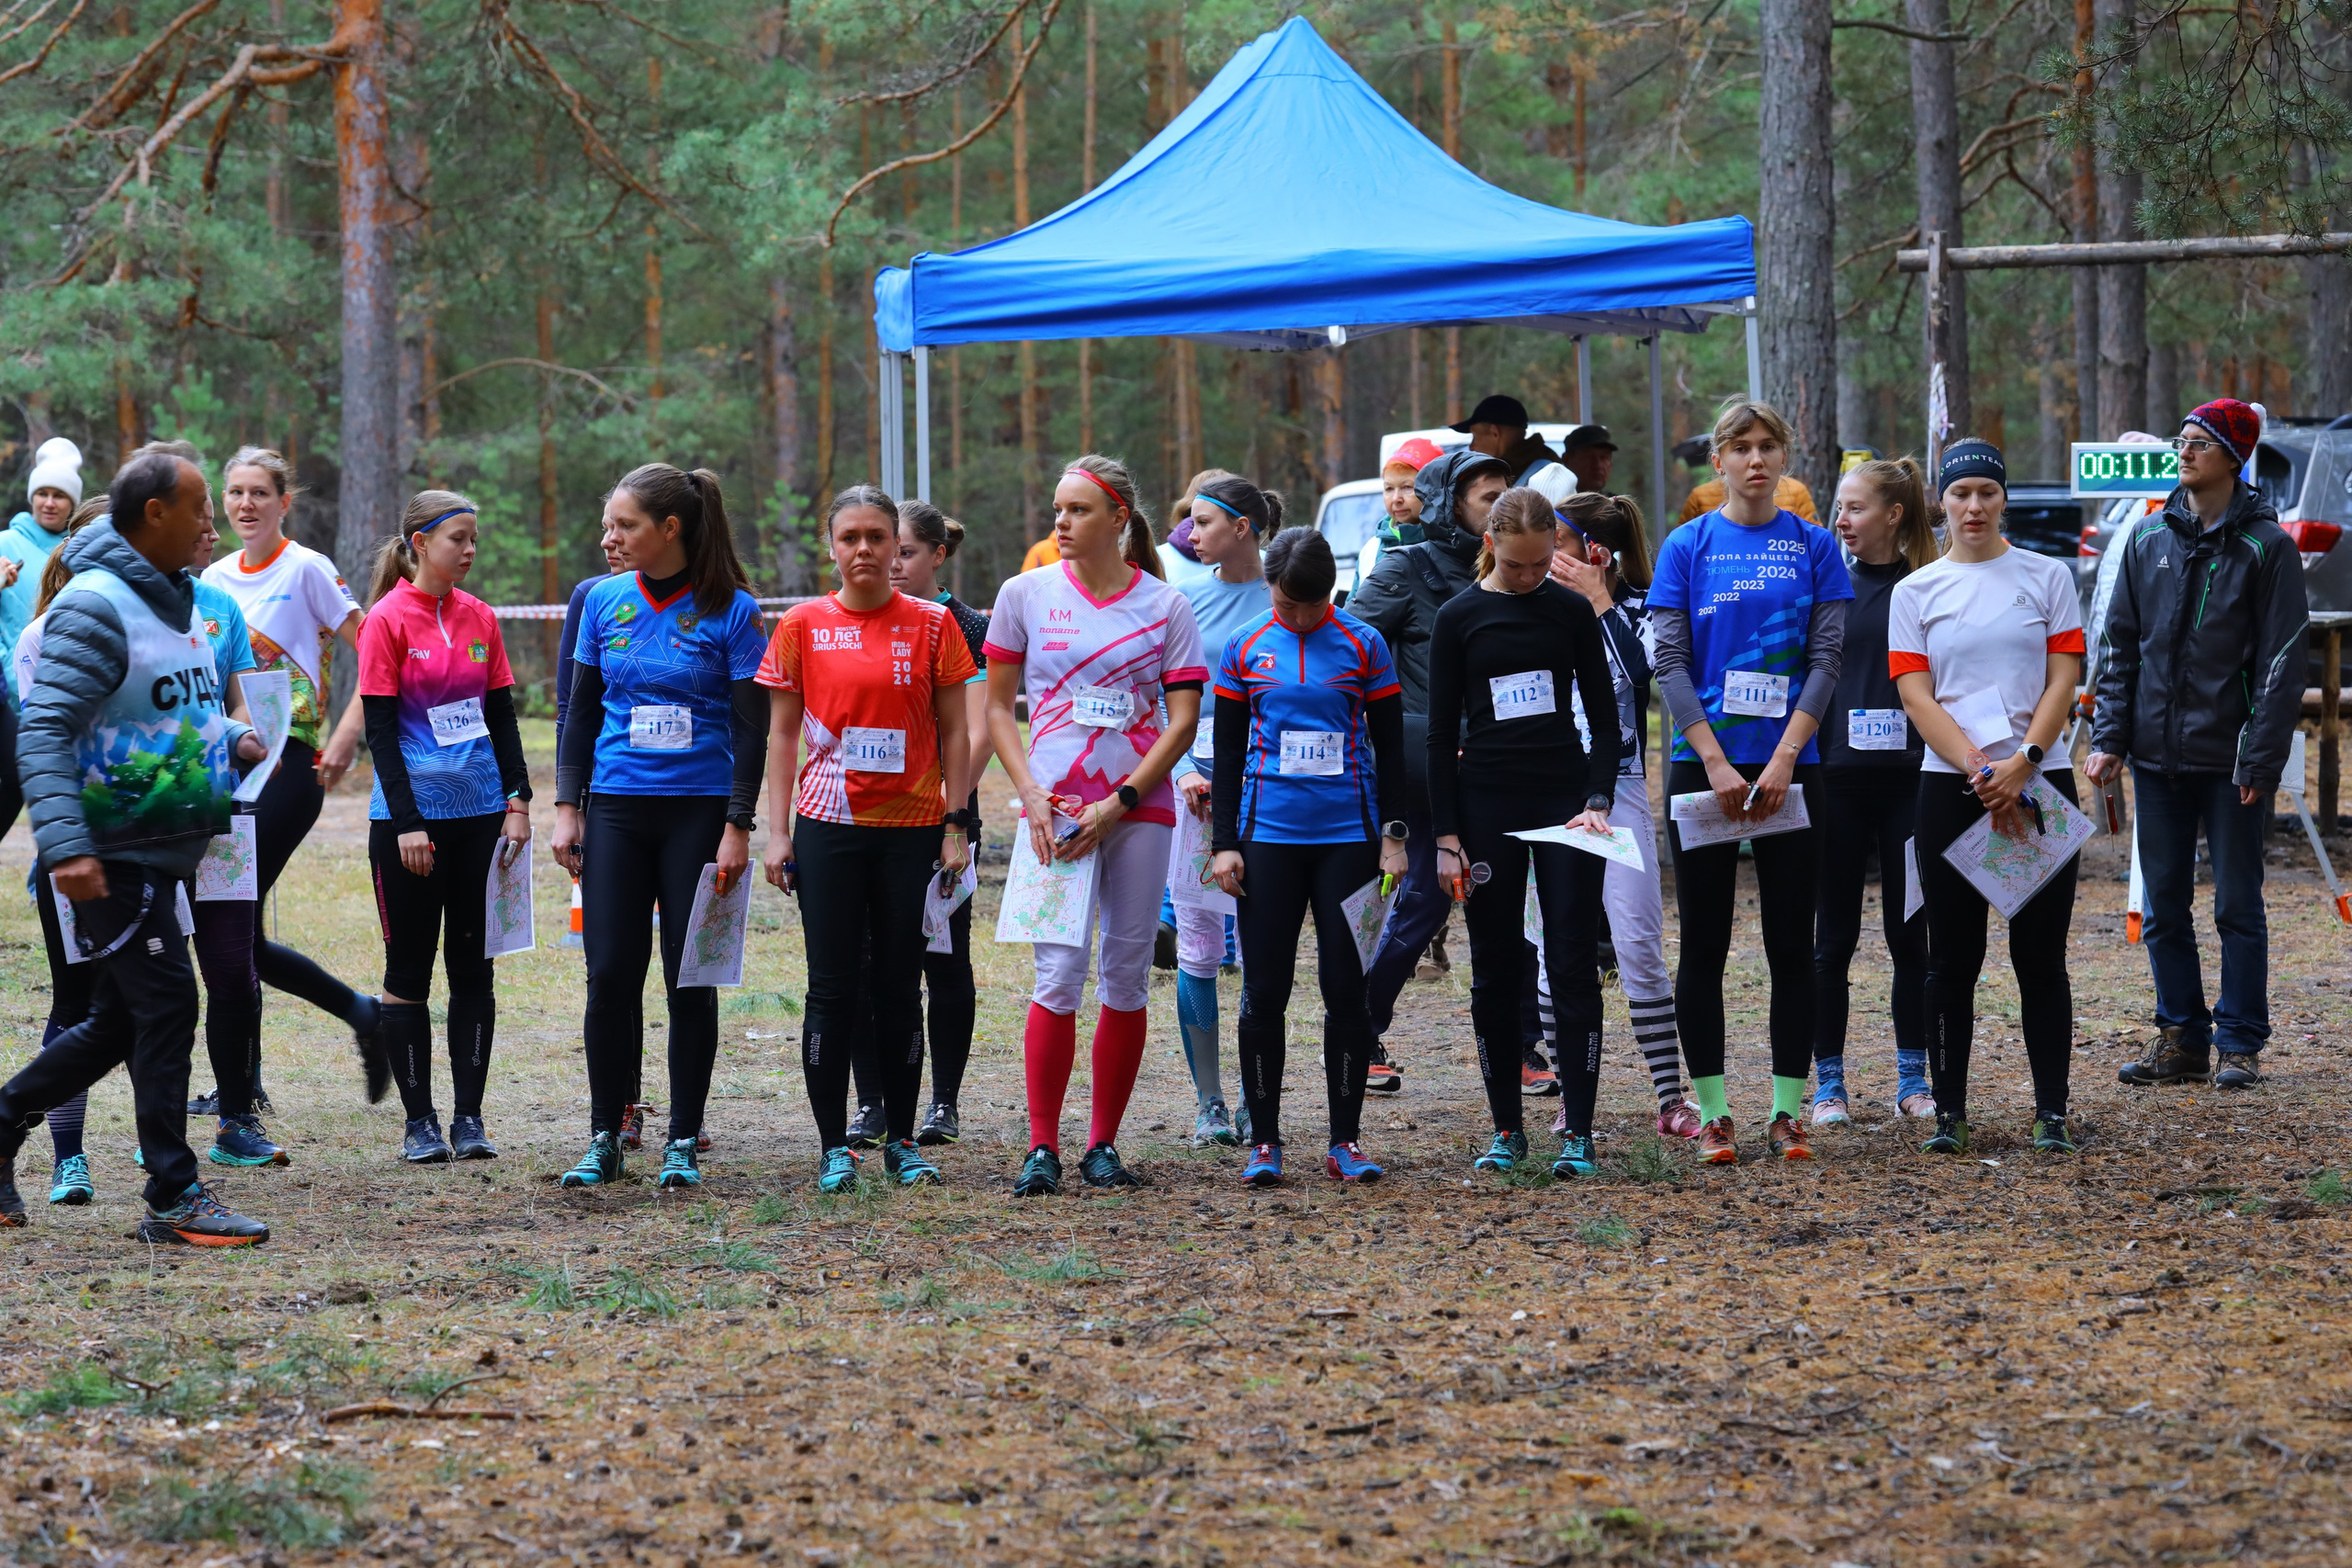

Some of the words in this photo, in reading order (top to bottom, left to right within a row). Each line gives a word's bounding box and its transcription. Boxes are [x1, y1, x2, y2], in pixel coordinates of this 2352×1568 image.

[1945, 454, 2004, 470] ORIENTEAM
[1767, 538, 1806, 555] 2025
[1705, 554, 1741, 562] ТРОПА
[1746, 553, 1797, 562] ЗАЙЦЕВА
[1706, 566, 1750, 576] ТЮМЕНЬ
[1757, 566, 1797, 580] 2024
[1732, 580, 1765, 590] 2023
[1713, 592, 1740, 603] 2022
[1049, 608, 1071, 623] KM
[1698, 606, 1717, 615] 2021
[811, 628, 831, 643] 10
[834, 630, 862, 642] лет
[812, 643, 837, 651] SIRIUS
[838, 641, 863, 650] SOCHI
[892, 649, 911, 657] LADY
[1511, 687, 1537, 704] 112
[1745, 687, 1767, 703] 111
[1092, 701, 1115, 716] 115
[447, 713, 469, 730] 126
[649, 721, 673, 735] 117
[1866, 723, 1892, 736] 120
[861, 745, 887, 760] 116
[1300, 745, 1325, 760] 114
[1587, 1032, 1599, 1072] noname
